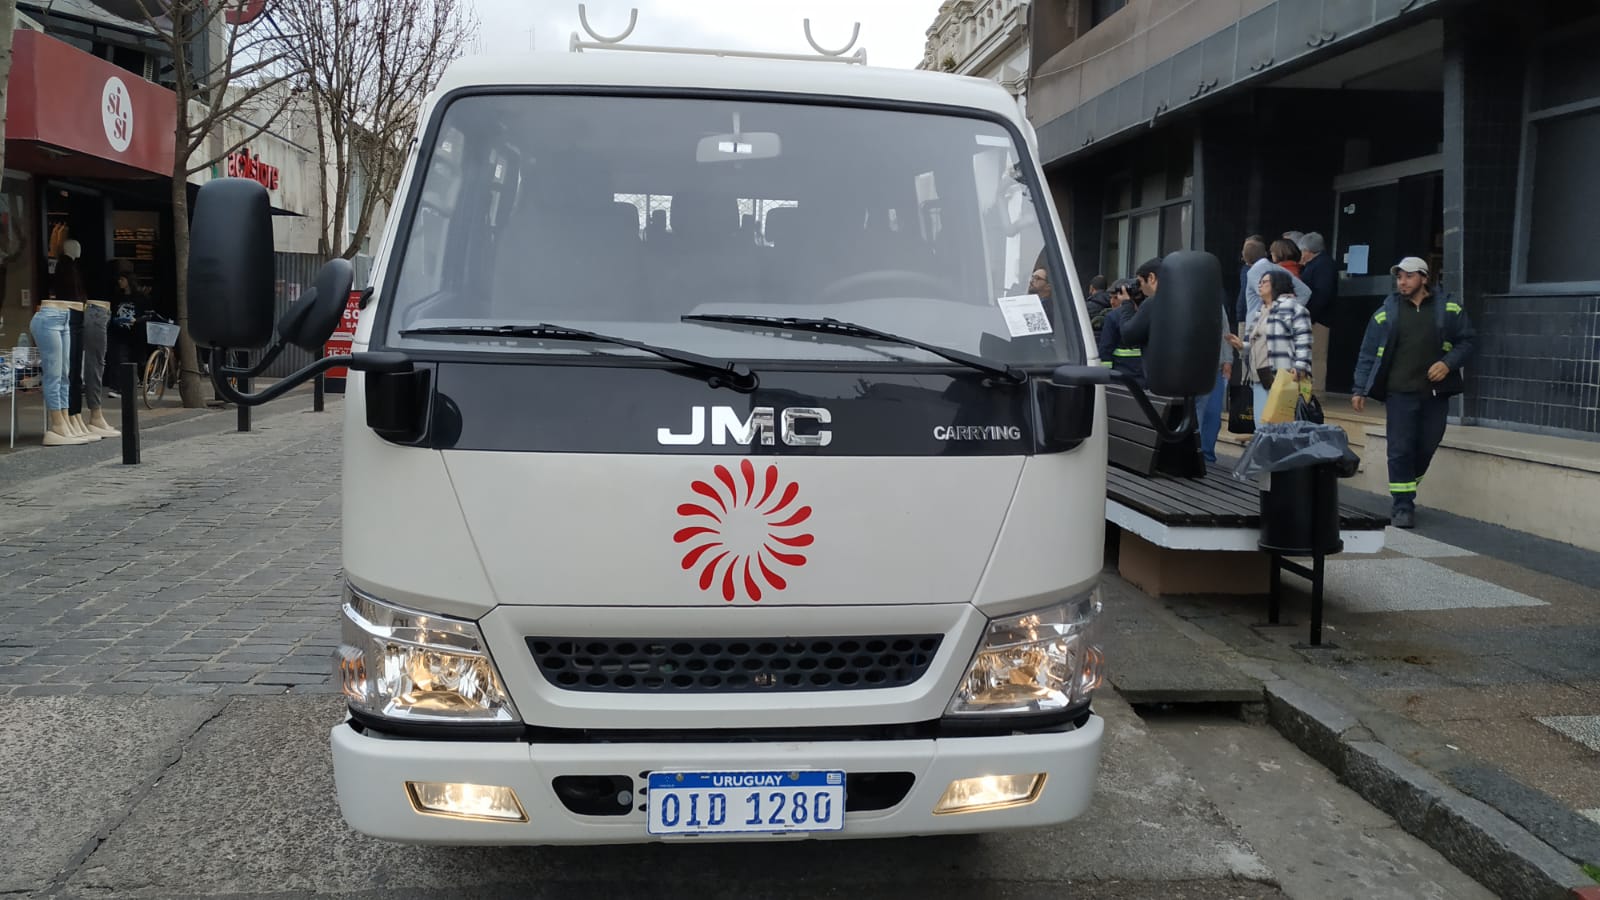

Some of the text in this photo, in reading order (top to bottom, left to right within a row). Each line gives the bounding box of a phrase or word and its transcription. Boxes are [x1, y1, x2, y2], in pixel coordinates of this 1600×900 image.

[107, 86, 121, 116] si
[114, 112, 127, 141] si
[657, 406, 832, 447] JMC
[933, 425, 1021, 441] CARRYING
[712, 774, 783, 787] URUGUAY
[661, 791, 831, 827] OID 1280
